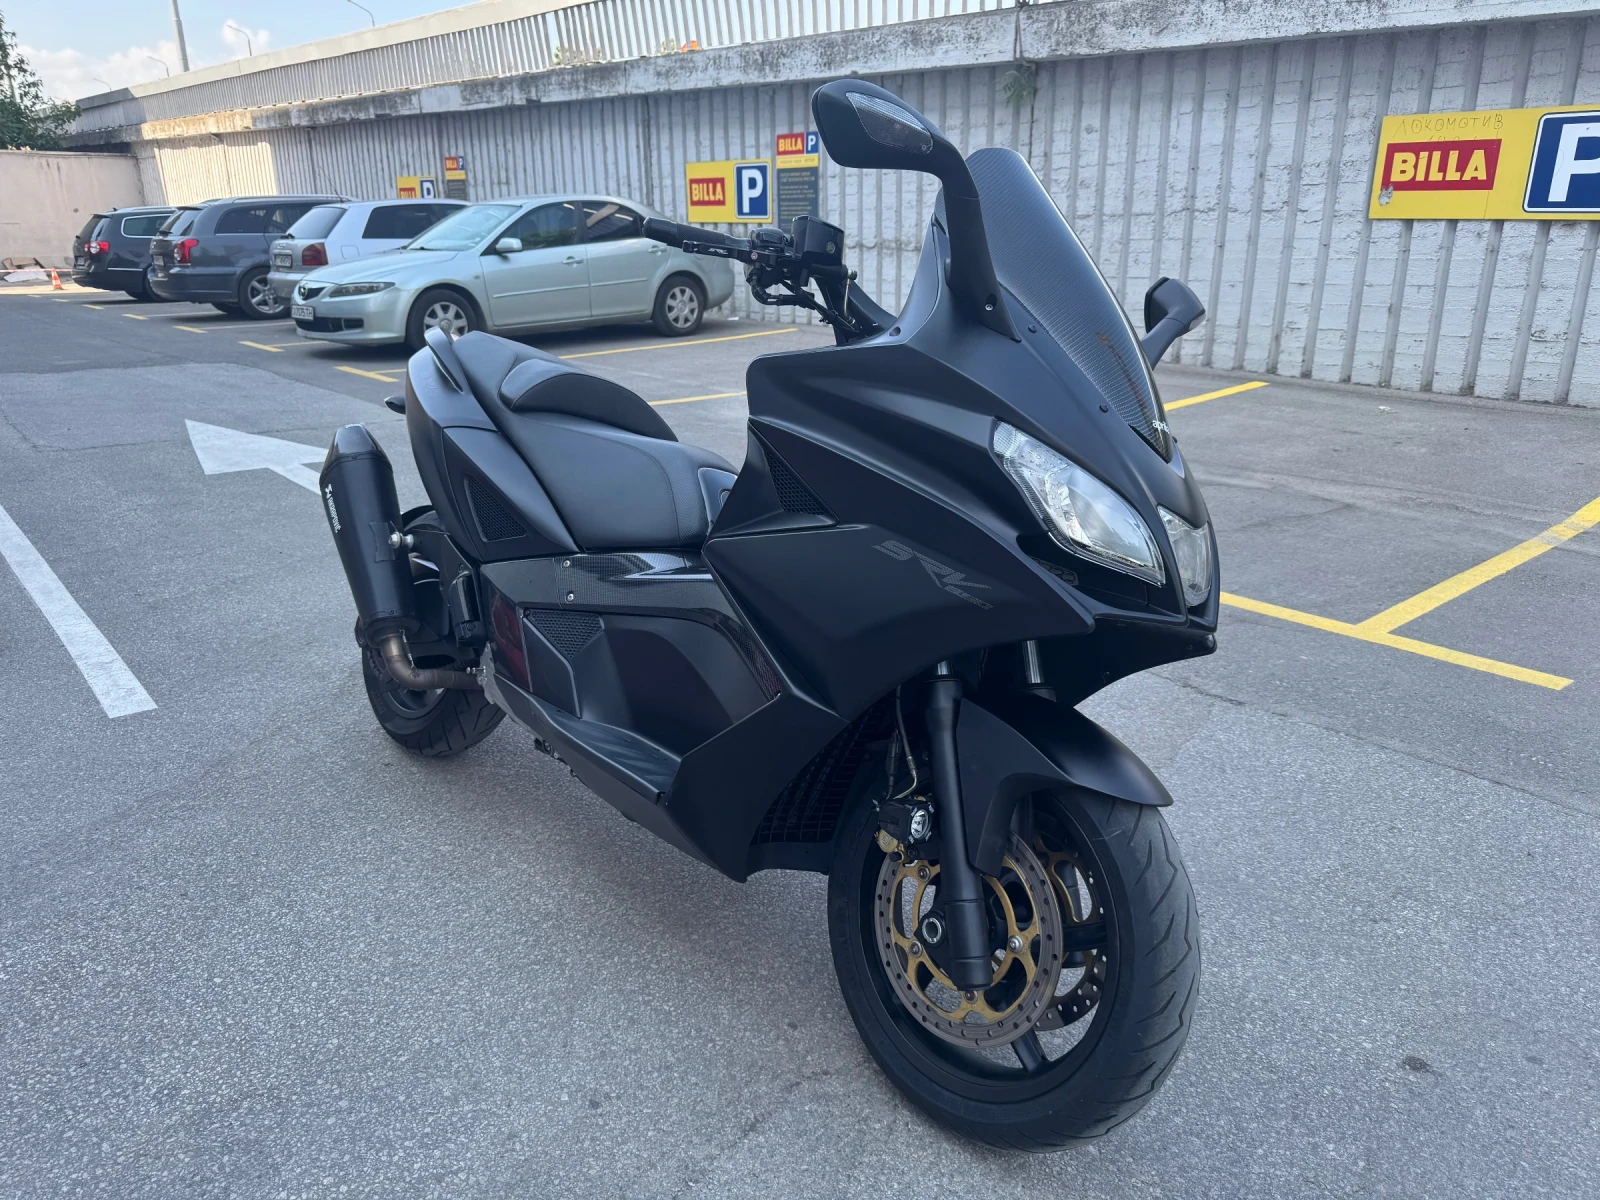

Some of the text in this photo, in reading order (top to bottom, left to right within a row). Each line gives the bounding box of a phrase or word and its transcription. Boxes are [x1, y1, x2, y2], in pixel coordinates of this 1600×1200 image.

[1393, 113, 1504, 138] ЛОКОМОТИВ
[778, 134, 816, 152] BILLA P
[1390, 122, 1600, 202] BILLA P
[692, 183, 723, 201] BILLA
[742, 169, 763, 213] P
